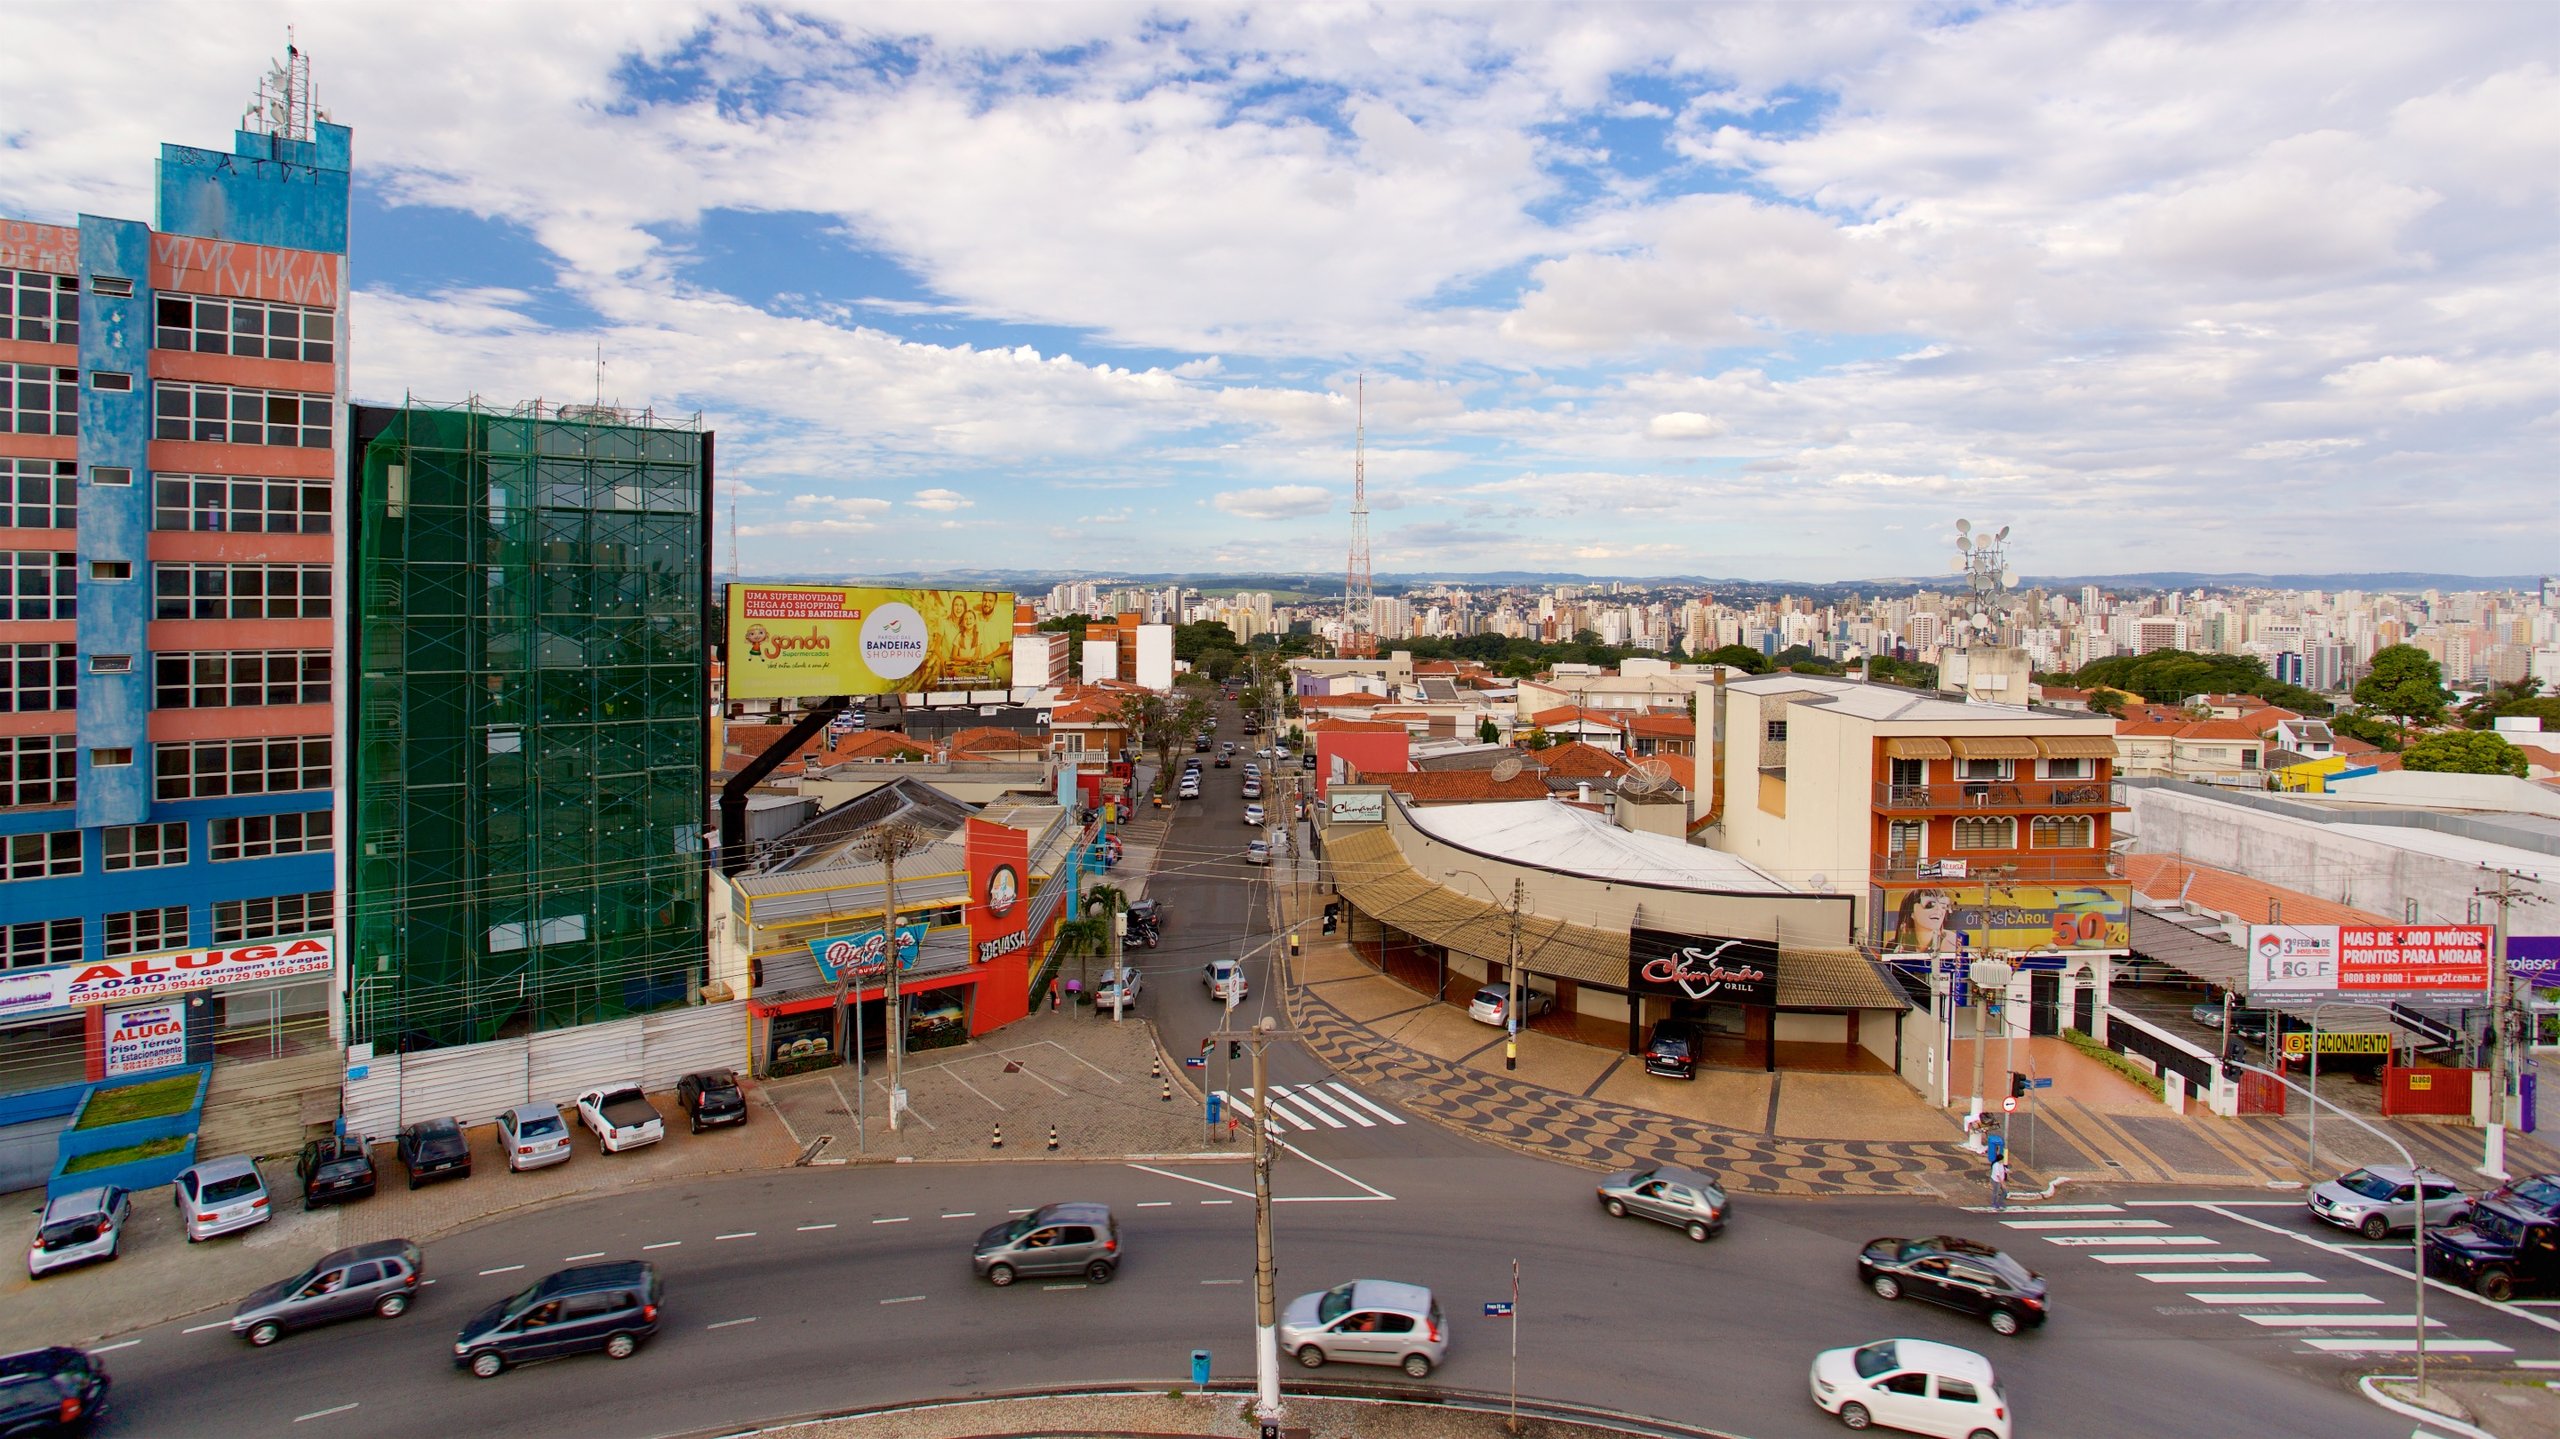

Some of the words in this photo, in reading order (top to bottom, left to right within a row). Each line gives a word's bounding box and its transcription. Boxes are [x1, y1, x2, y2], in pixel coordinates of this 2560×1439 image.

[747, 592, 768, 600] UMA
[770, 592, 844, 602] SUPERNOVIDADE
[747, 601, 778, 609] CHEGA
[780, 601, 793, 609] AO
[795, 602, 840, 610] SHOPPING
[746, 609, 785, 617] PARQUE
[787, 610, 806, 618] DAS
[808, 610, 860, 619] BANDEIRAS
[866, 640, 922, 650] BANDEIRAS
[782, 650, 830, 658] Supermercados
[866, 650, 922, 659] SHOPPING
[1966, 912, 2004, 926] ÓTAS
[2007, 912, 2049, 925] CAROL
[2052, 911, 2129, 946] 50%
[2321, 938, 2331, 948] DE
[2343, 931, 2375, 946] MAIS
[2377, 931, 2394, 946] DE
[2434, 928, 2483, 947] IMÓVEIS
[986, 929, 1026, 961] DEVASSA
[72, 939, 328, 984] ALUGA
[2343, 949, 2400, 964] PRONTOS
[2402, 949, 2436, 964] PARA
[2438, 949, 2482, 964] MORAR
[168, 972, 188, 982] m²
[200, 963, 265, 977] Garagem
[288, 954, 329, 965] vagas
[2343, 972, 2363, 983] 0800
[2382, 972, 2403, 983] 0800
[2415, 973, 2482, 984] www.g2f.com.br
[1724, 982, 1754, 992] GRILL
[763, 1006, 783, 1018] 376
[112, 1021, 182, 1043] ALUGA
[110, 1044, 138, 1055] Piso
[141, 1036, 181, 1049] Térreo
[120, 1045, 183, 1063] Estacionamento
[2412, 1076, 2431, 1084] ALUGO
